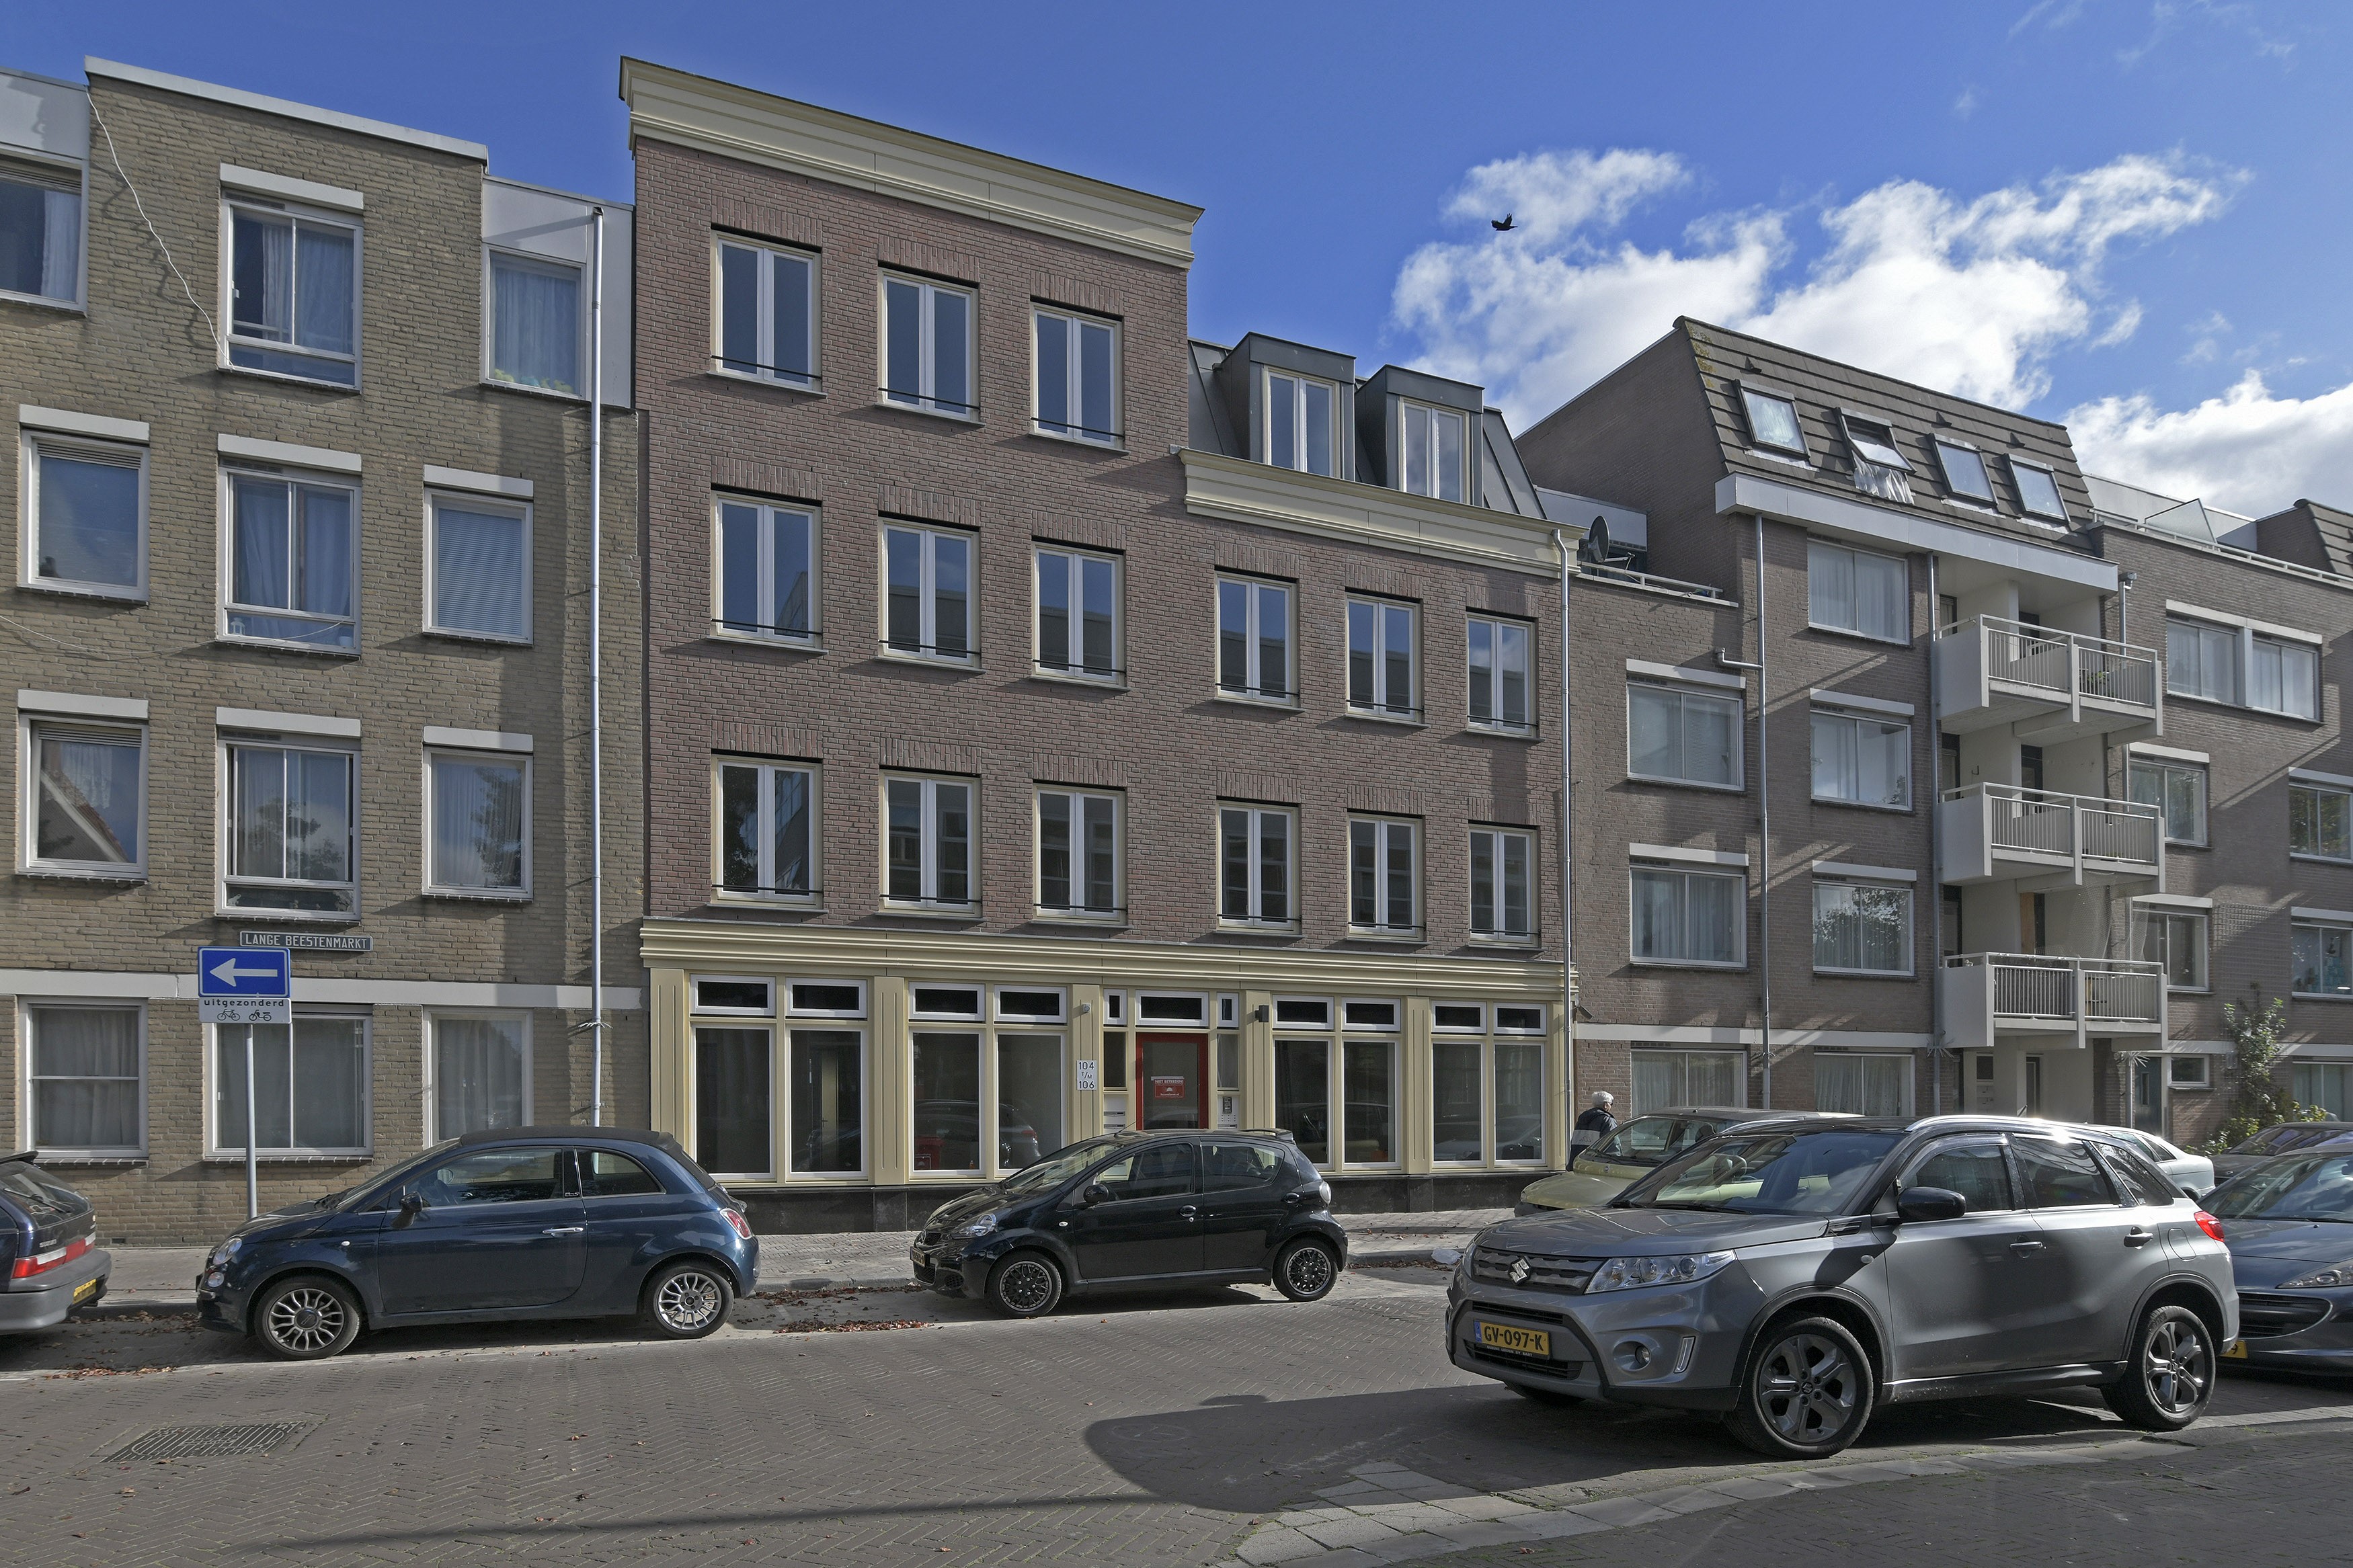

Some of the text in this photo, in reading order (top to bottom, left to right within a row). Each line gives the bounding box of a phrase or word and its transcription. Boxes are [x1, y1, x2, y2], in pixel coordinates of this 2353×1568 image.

[245, 934, 367, 949] LANGE BEESTENMARKT
[204, 999, 284, 1007] uitgezonderd
[1079, 1081, 1094, 1089] 106
[1484, 1325, 1544, 1352] GV-097-K
